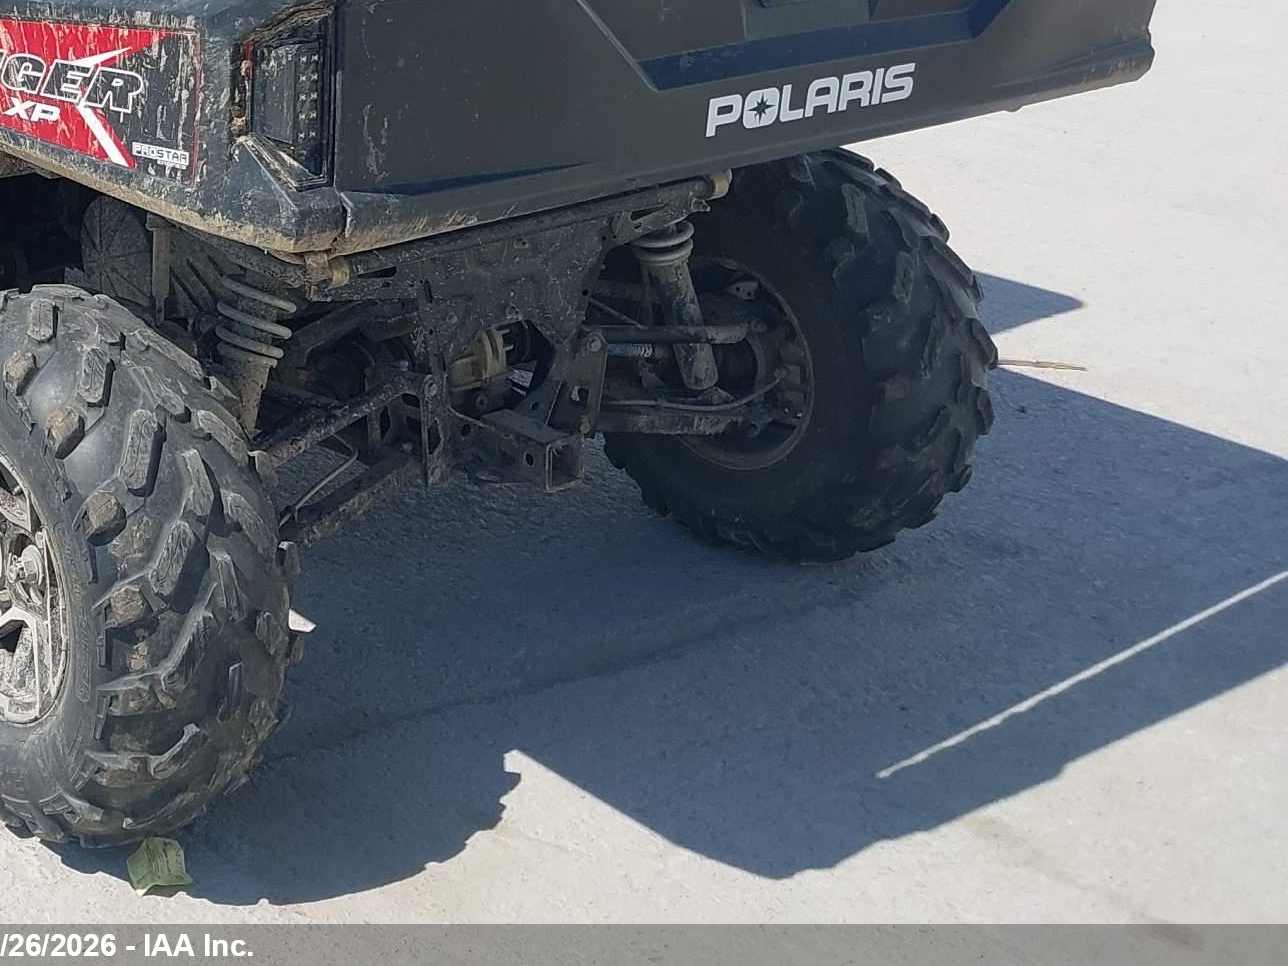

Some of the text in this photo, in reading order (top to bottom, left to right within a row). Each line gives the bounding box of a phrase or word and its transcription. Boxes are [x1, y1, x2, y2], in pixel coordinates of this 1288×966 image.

[3, 96, 61, 122] XP
[706, 63, 916, 138] POLARIS
[133, 143, 189, 165] PROSTAR
